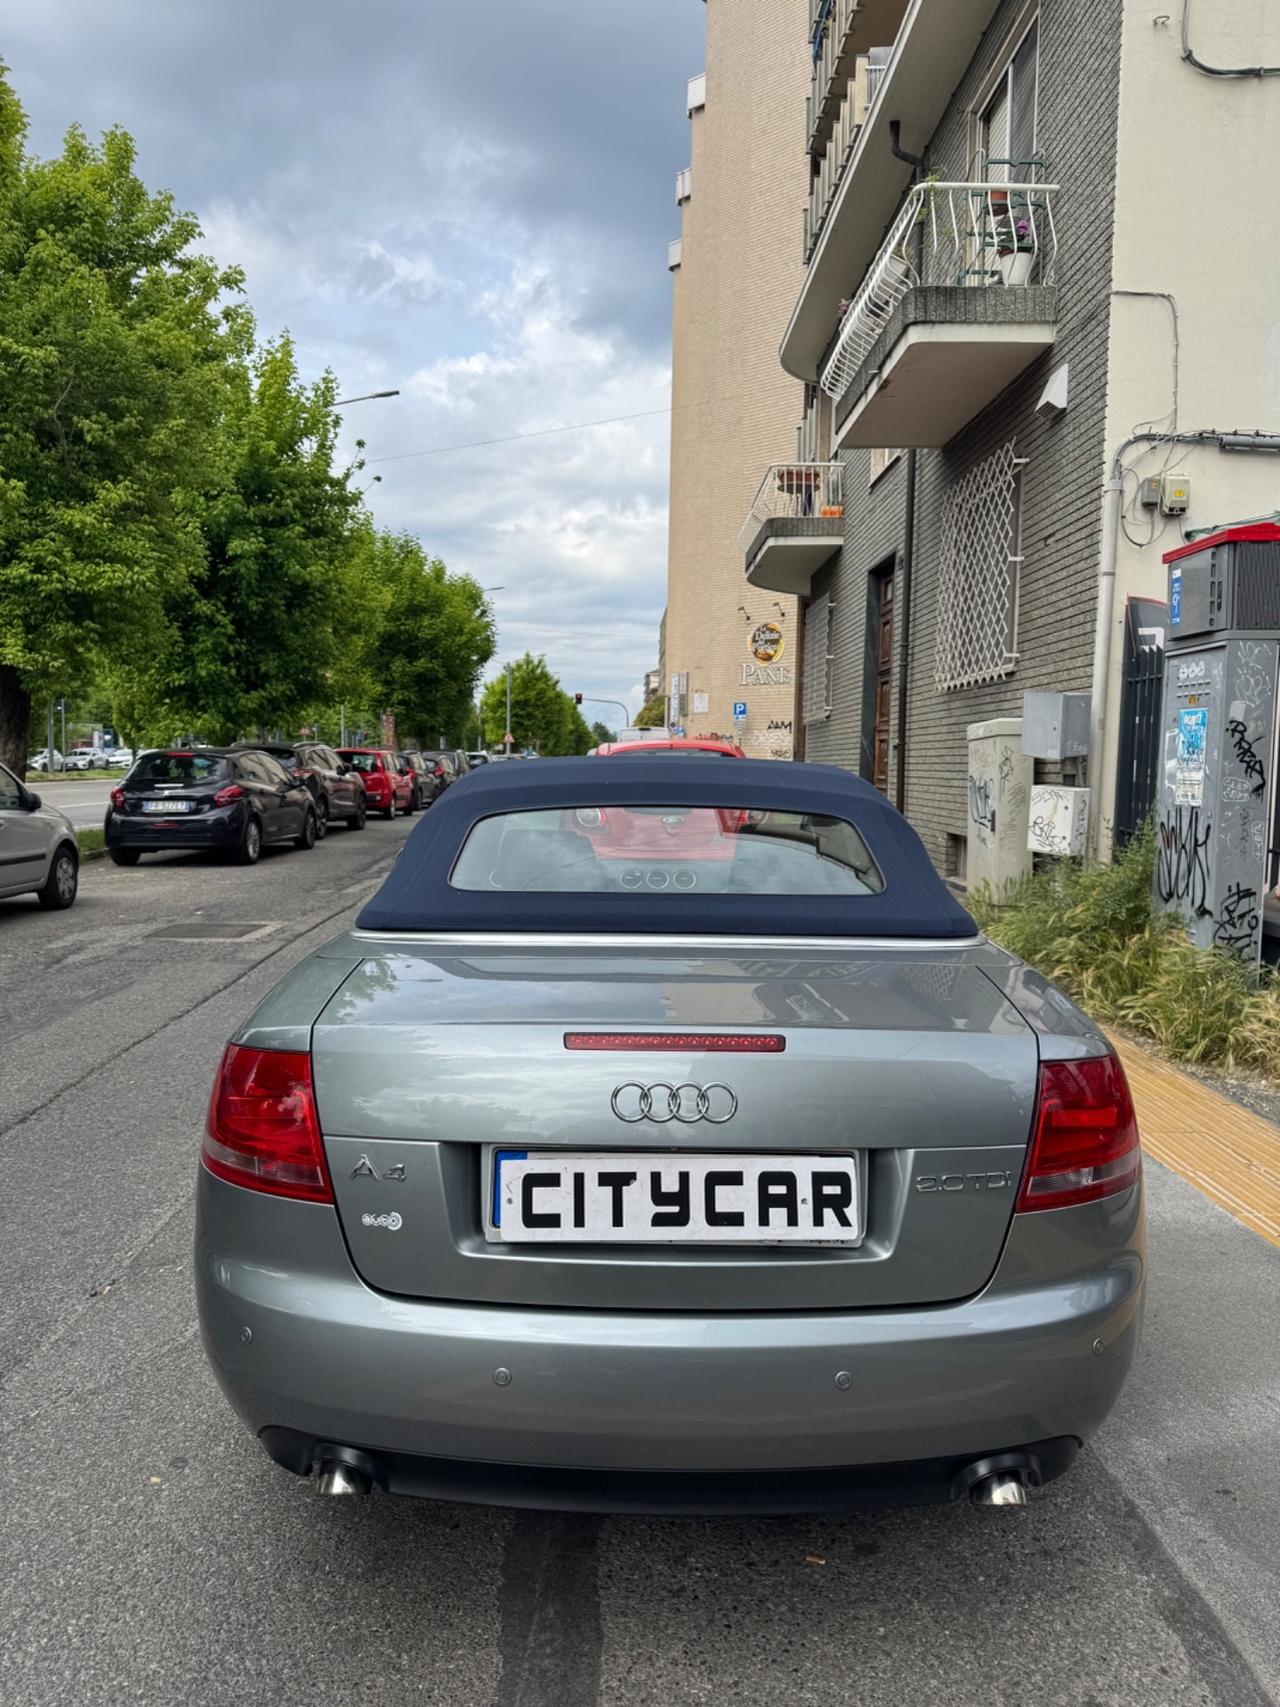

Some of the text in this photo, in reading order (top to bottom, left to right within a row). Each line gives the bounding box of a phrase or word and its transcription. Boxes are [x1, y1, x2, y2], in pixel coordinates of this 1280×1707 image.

[740, 664, 790, 686] PANE
[736, 704, 745, 714] P
[521, 1171, 853, 1228] CITYCAR
